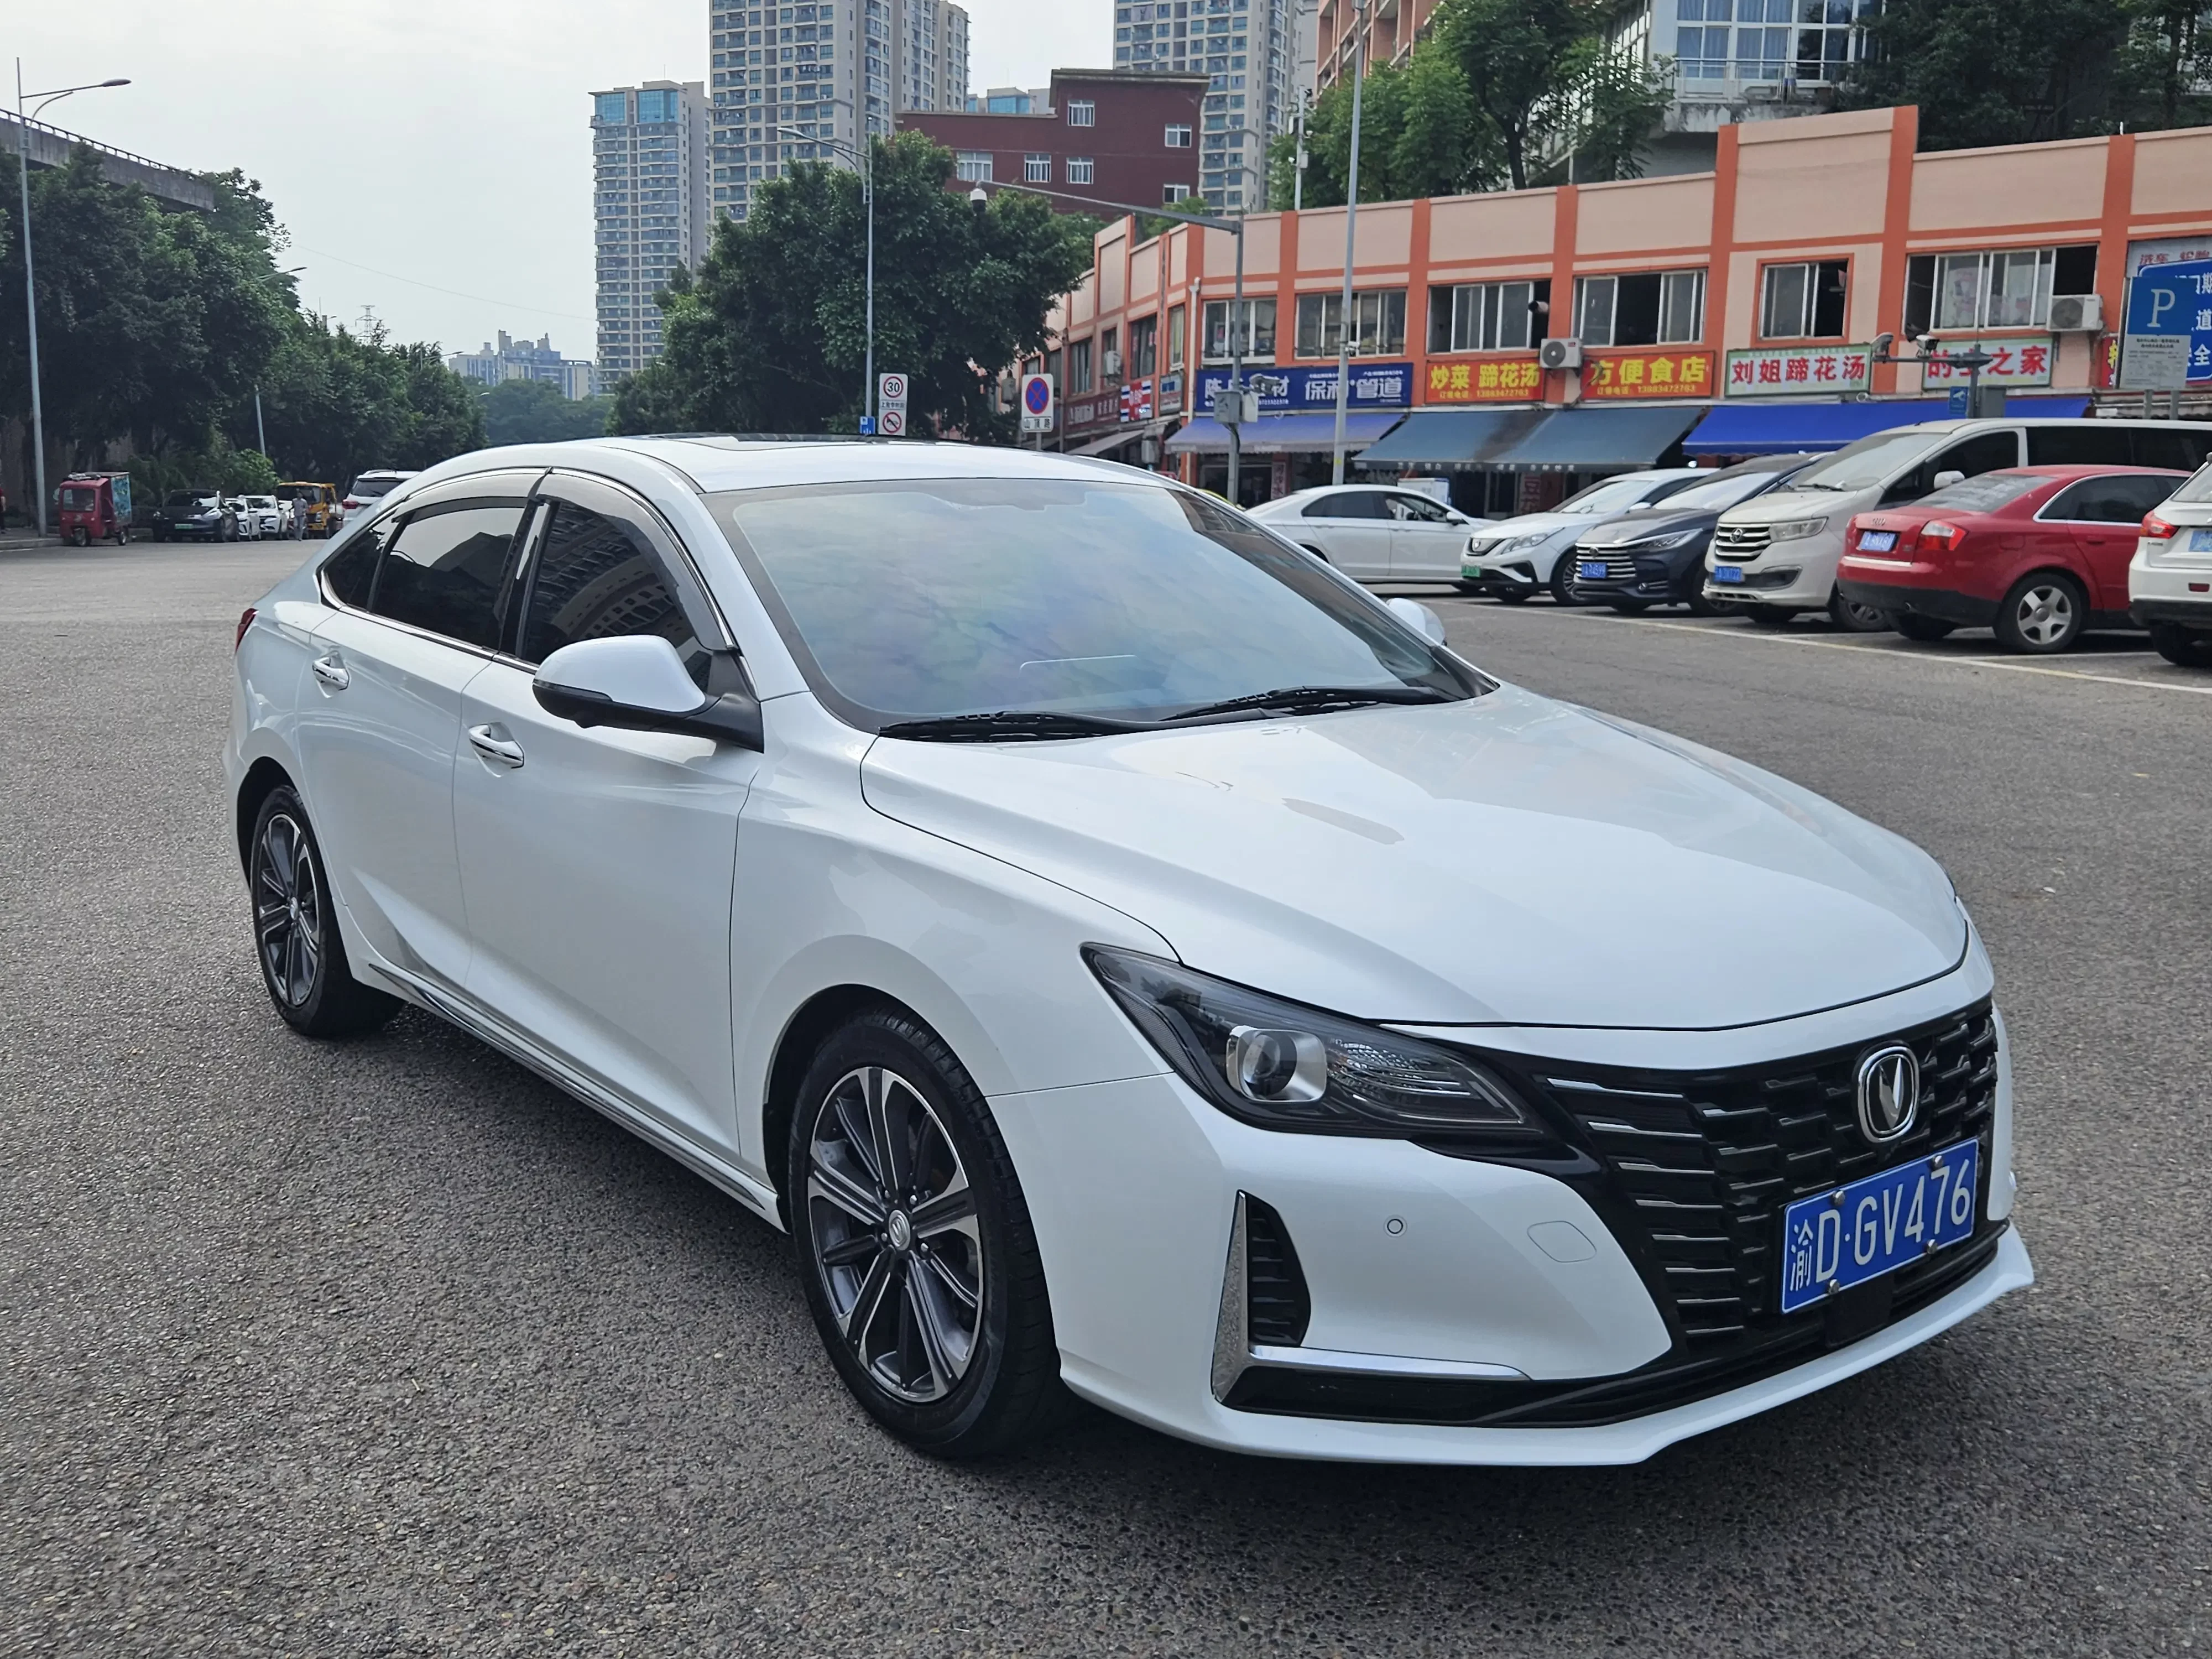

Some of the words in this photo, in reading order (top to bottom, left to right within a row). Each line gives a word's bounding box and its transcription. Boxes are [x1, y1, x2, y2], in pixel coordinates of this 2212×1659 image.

[2147, 288, 2176, 328] P
[1431, 364, 1470, 390] 炒菜
[1478, 362, 1540, 388] 蹄花汤
[1590, 356, 1705, 385] 方便食店
[1731, 355, 1865, 385] 刘姐蹄花汤
[887, 382, 900, 392] 30
